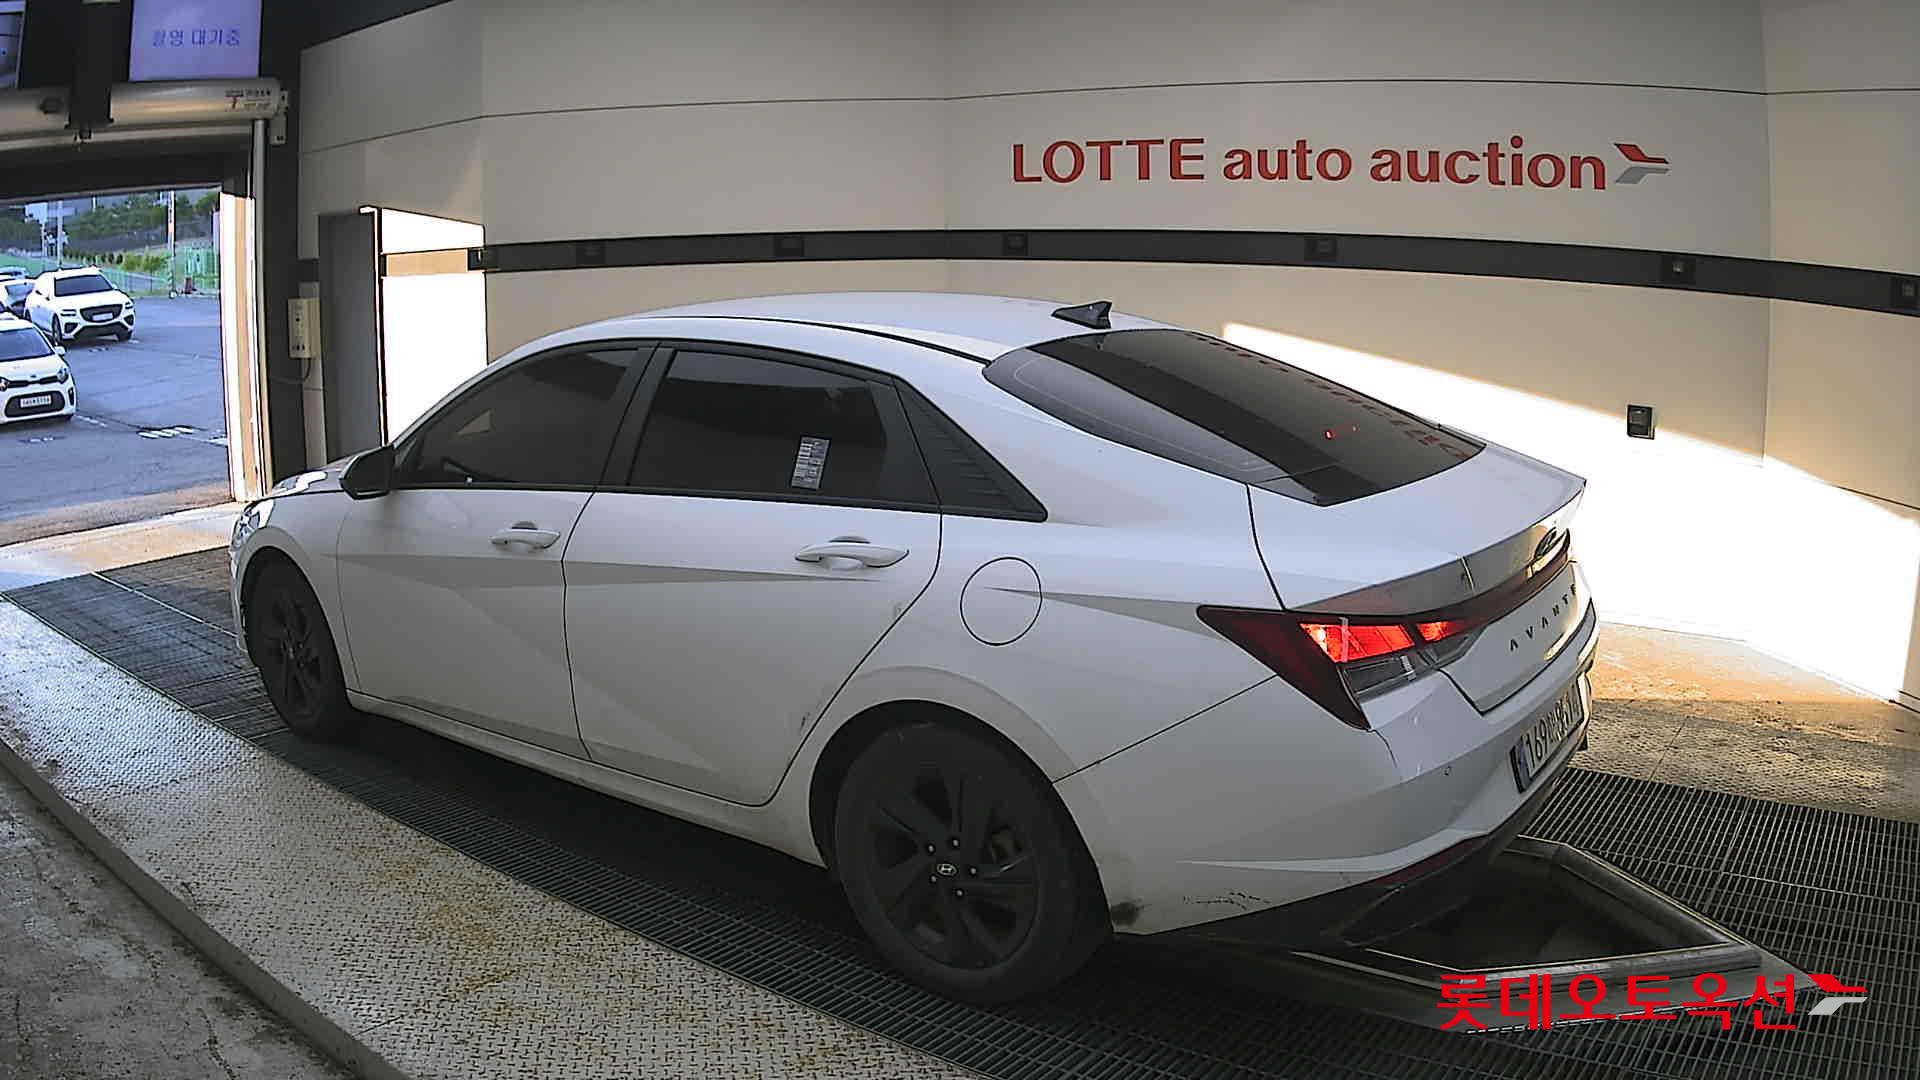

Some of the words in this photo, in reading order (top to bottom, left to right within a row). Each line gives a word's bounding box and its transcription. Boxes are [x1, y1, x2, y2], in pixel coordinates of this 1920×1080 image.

[1012, 138, 1205, 183] LOTTE
[1223, 139, 1353, 182] auto
[1369, 135, 1606, 190] auction
[1508, 583, 1578, 652] AVANTE
